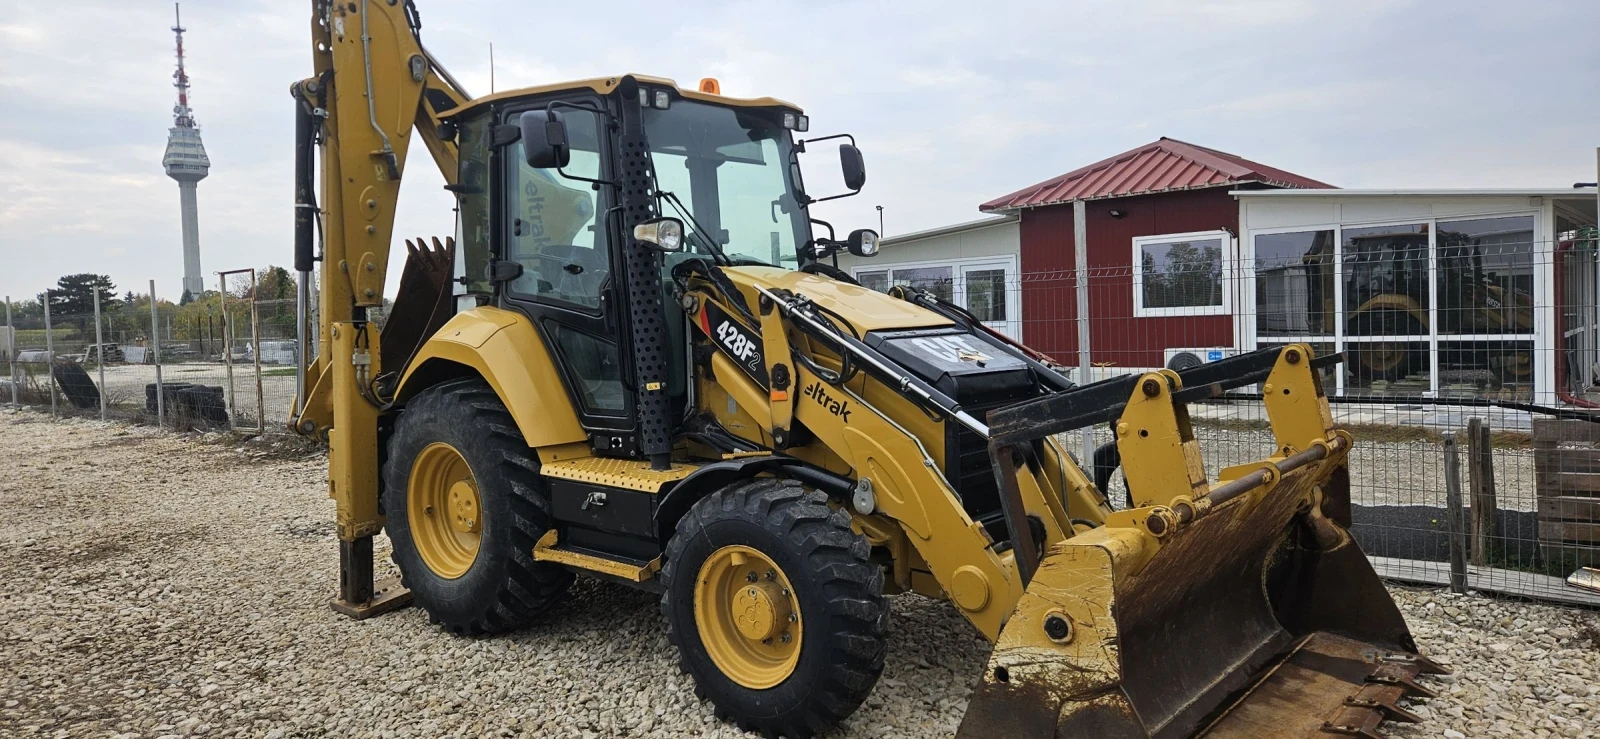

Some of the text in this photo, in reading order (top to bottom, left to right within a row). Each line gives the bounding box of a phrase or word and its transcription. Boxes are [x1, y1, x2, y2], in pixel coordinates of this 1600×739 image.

[525, 180, 551, 252] eltrak
[911, 335, 995, 362] CAT
[804, 381, 852, 424] eltrak
